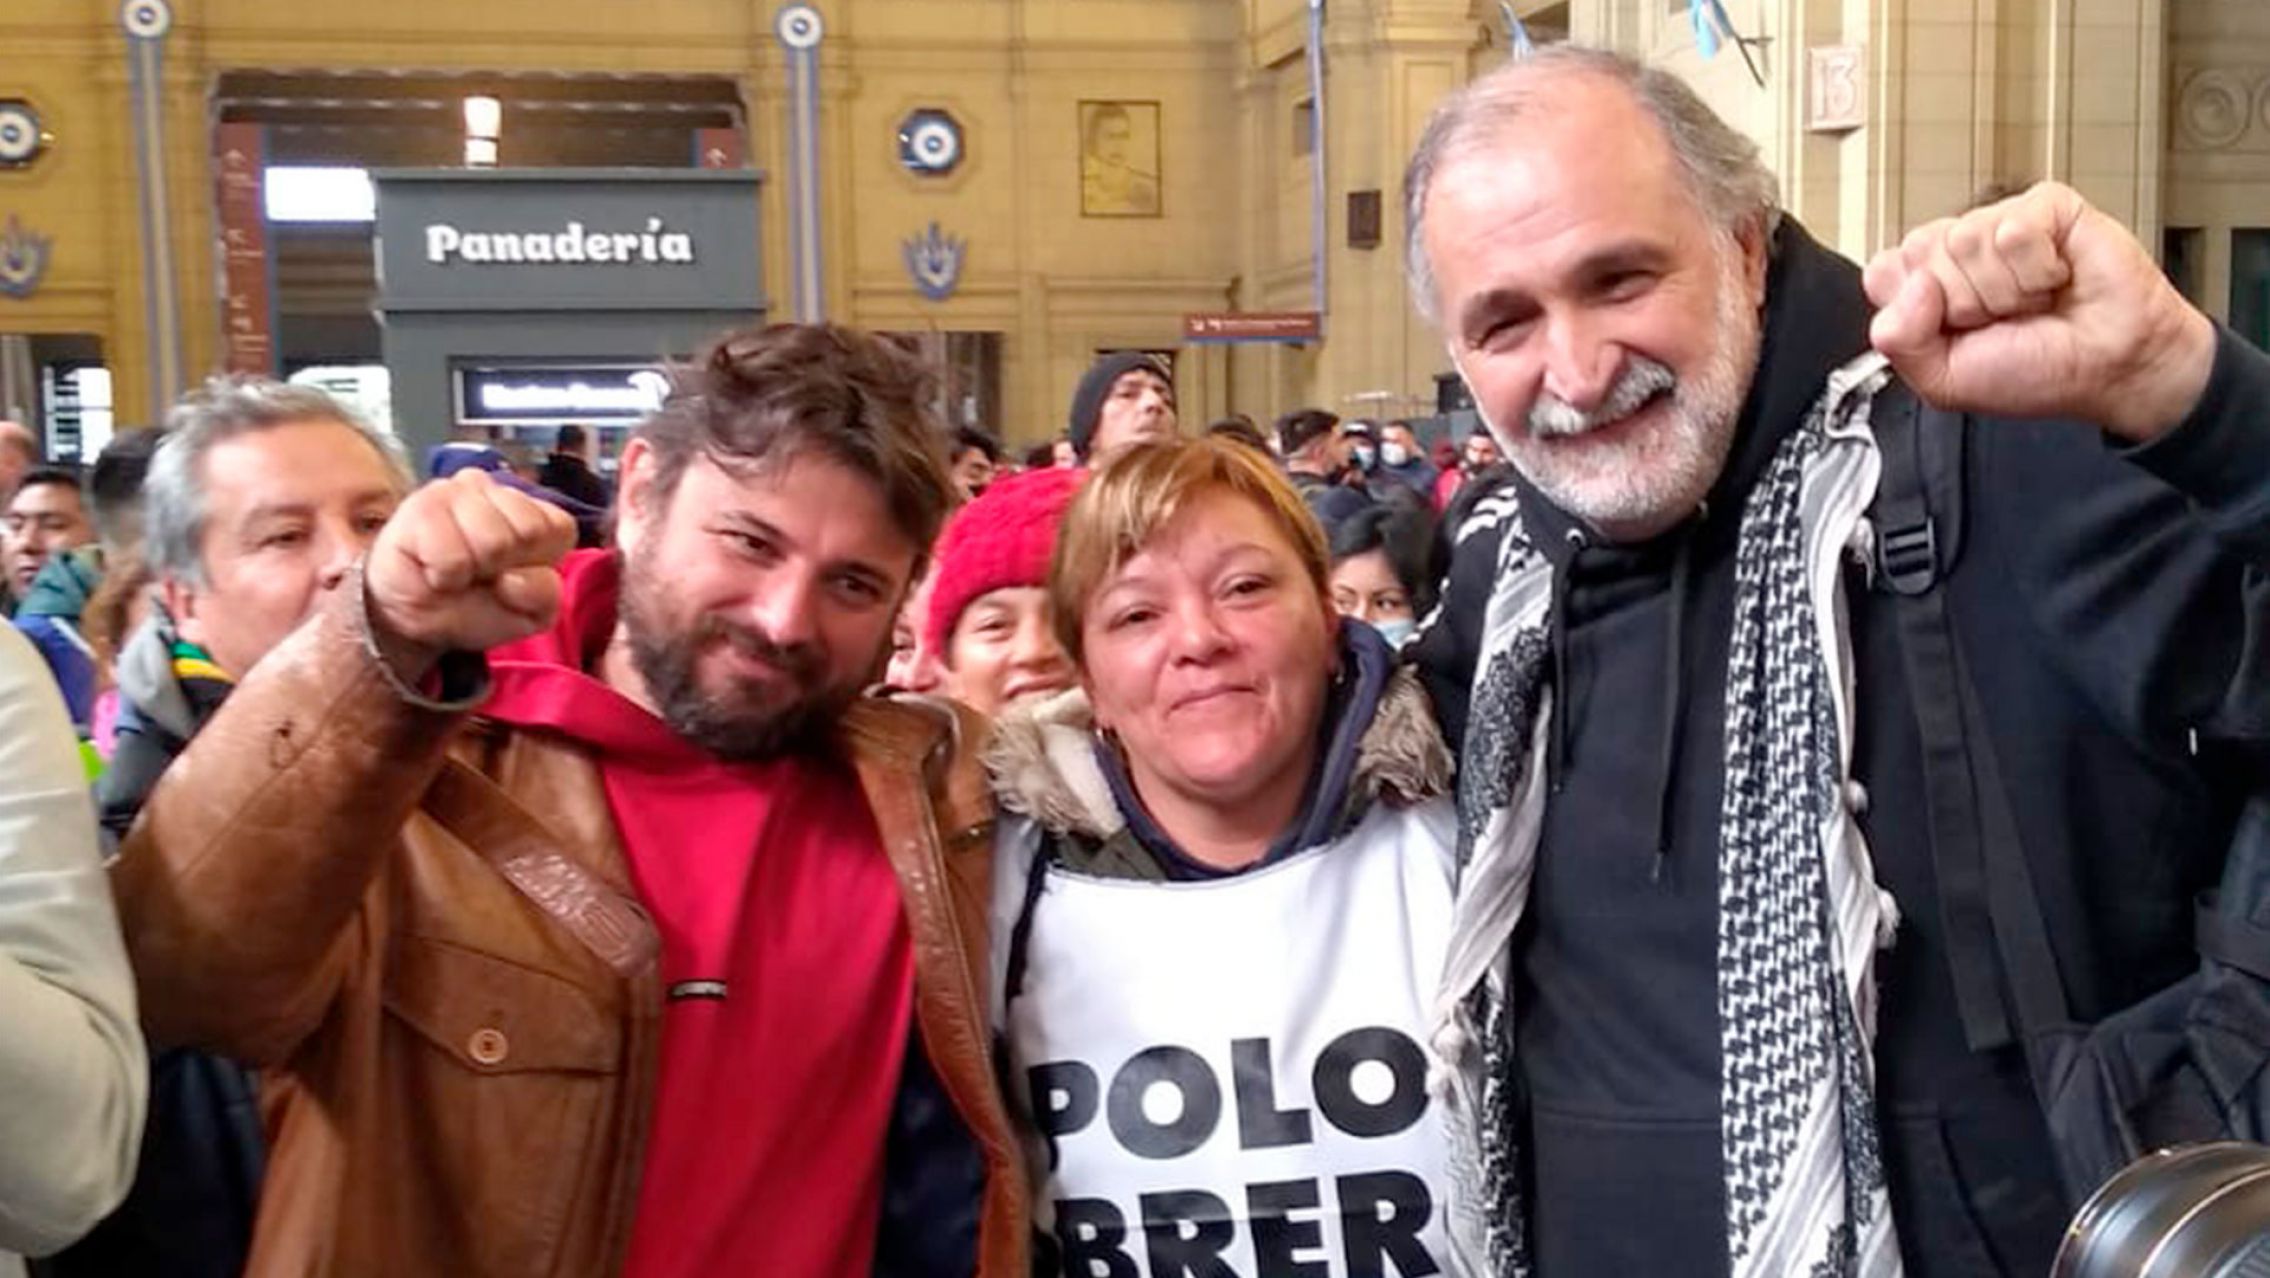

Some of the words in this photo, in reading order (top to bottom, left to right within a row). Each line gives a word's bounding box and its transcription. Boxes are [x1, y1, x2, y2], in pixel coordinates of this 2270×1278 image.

[1813, 52, 1857, 120] 13
[425, 217, 693, 262] Panadería
[1028, 1026, 1431, 1171] POLO
[1036, 1169, 1449, 1278] BRER
